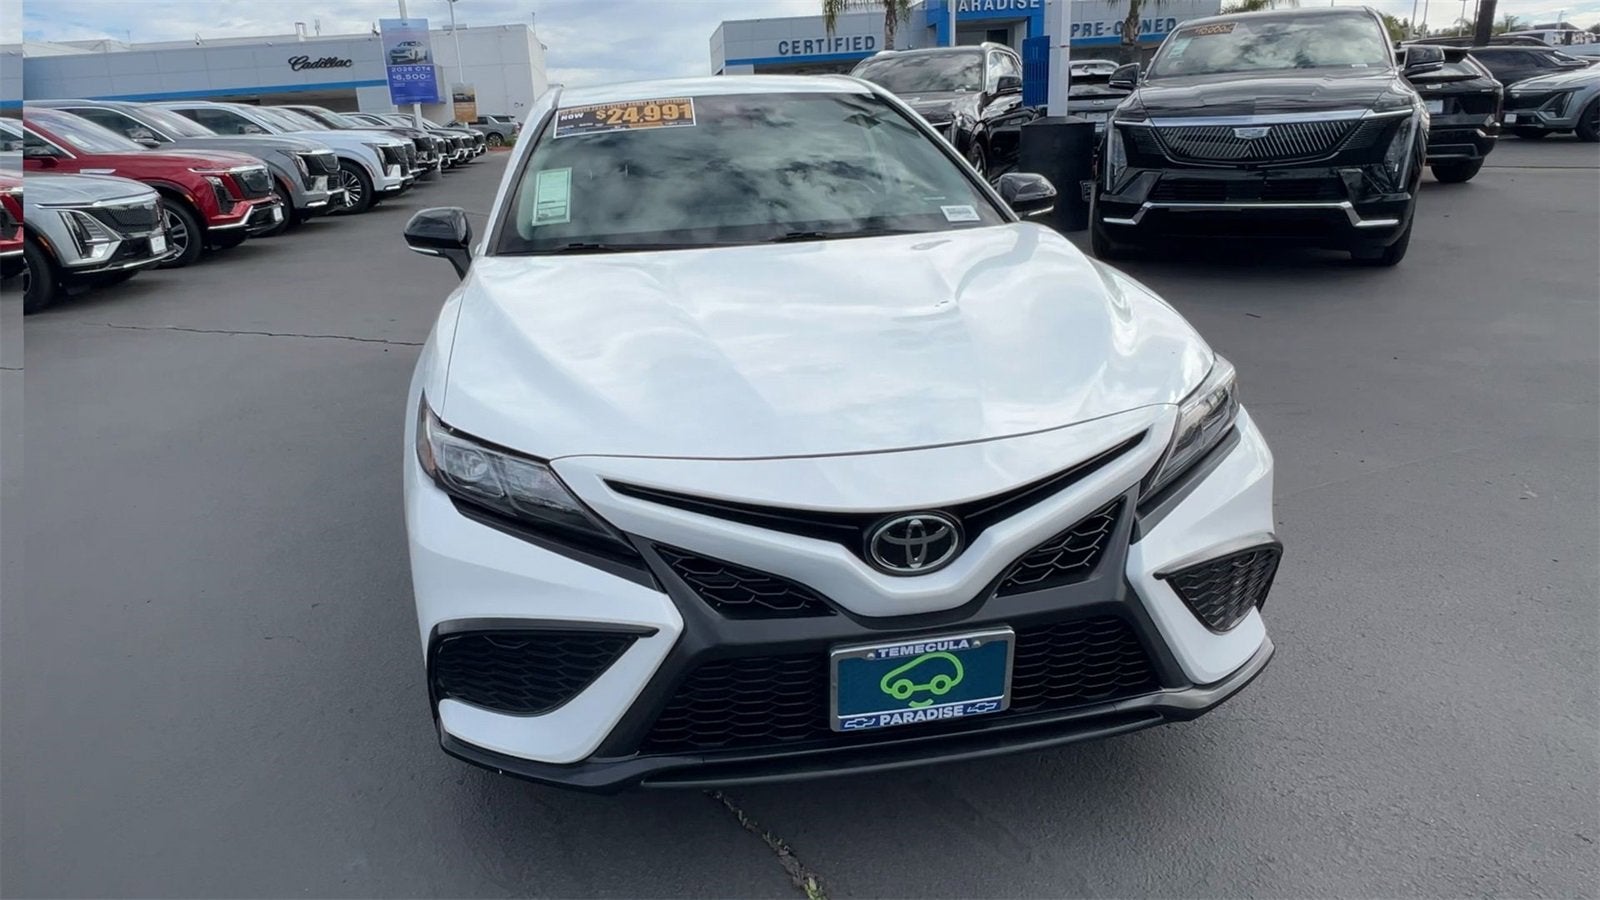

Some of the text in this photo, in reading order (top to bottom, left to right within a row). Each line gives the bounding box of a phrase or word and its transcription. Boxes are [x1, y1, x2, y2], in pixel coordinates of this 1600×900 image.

[1070, 18, 1177, 37] PRE-ONED
[778, 36, 875, 55] CERTIFIED
[288, 55, 353, 72] Cadillac
[561, 112, 584, 121] NOW
[878, 639, 969, 658] TEMECULA
[879, 705, 964, 726] PARADISE
